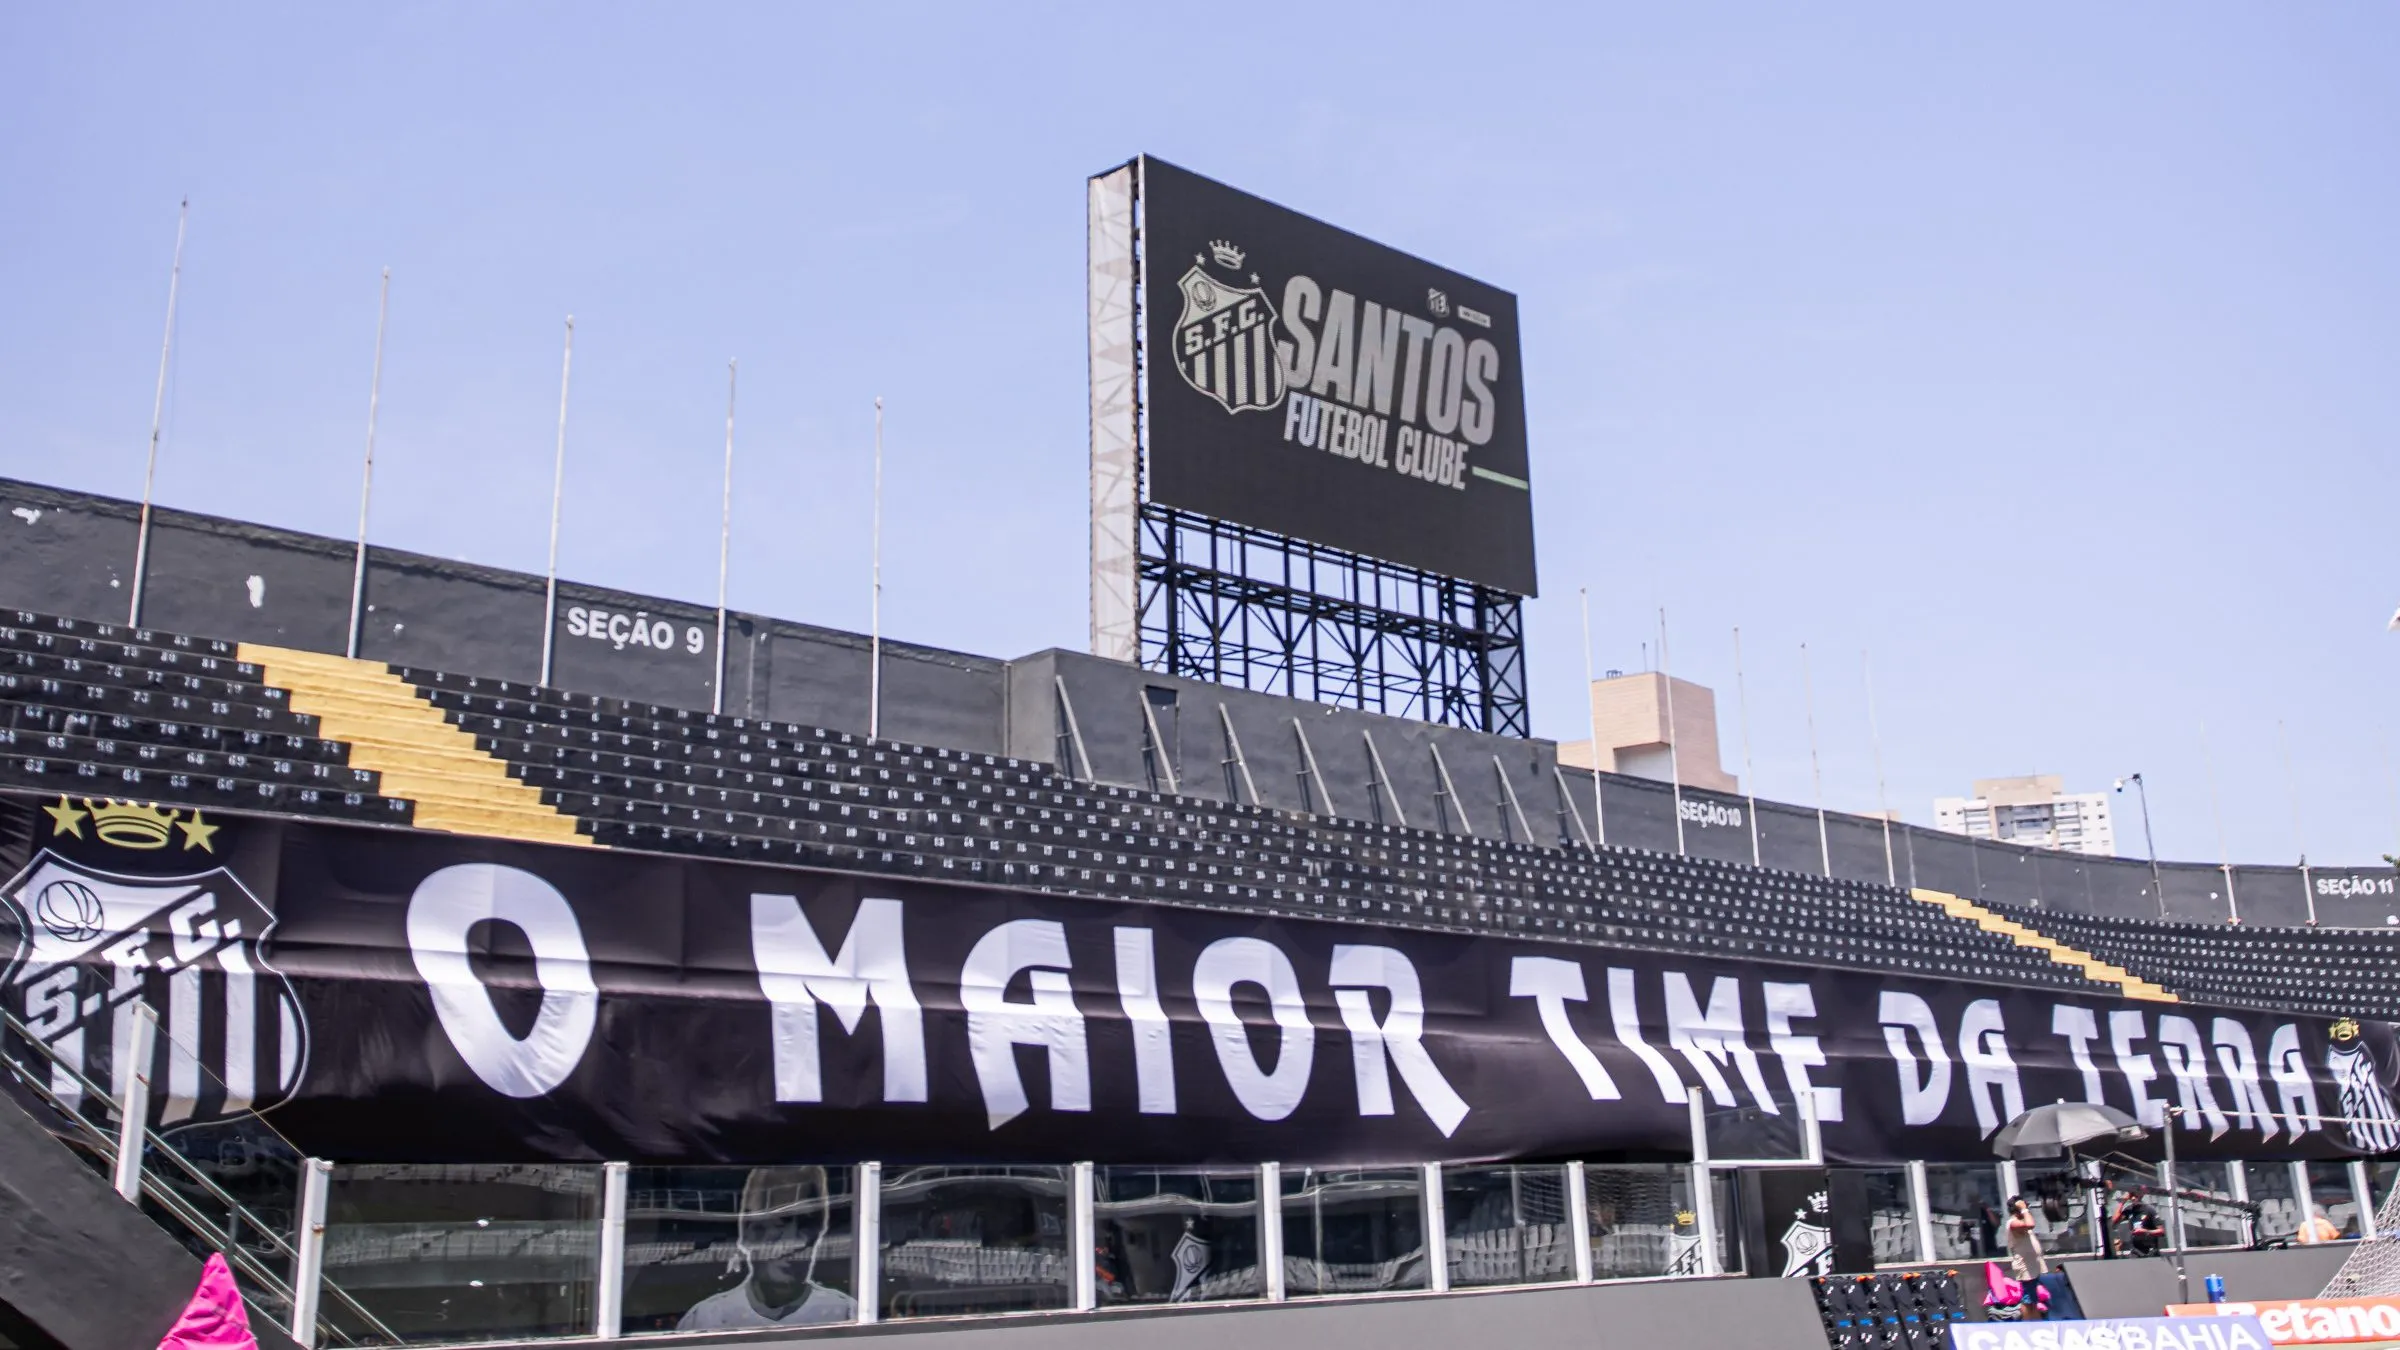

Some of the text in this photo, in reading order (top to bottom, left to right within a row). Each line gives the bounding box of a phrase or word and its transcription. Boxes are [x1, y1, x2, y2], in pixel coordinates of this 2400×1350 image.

[1185, 299, 1265, 356] S.F.C.
[1278, 275, 1499, 445] SANTOS
[1284, 391, 1469, 490] FUTEBOL CLUBE
[567, 606, 704, 654] SEÇÃO 9
[2316, 875, 2394, 899] SEÇÃO 11
[406, 863, 599, 1098] O
[751, 893, 1470, 1138] MAIOR
[1510, 956, 1843, 1122] TIME
[1878, 991, 2025, 1142] DA
[2052, 1003, 2323, 1145] TERRA
